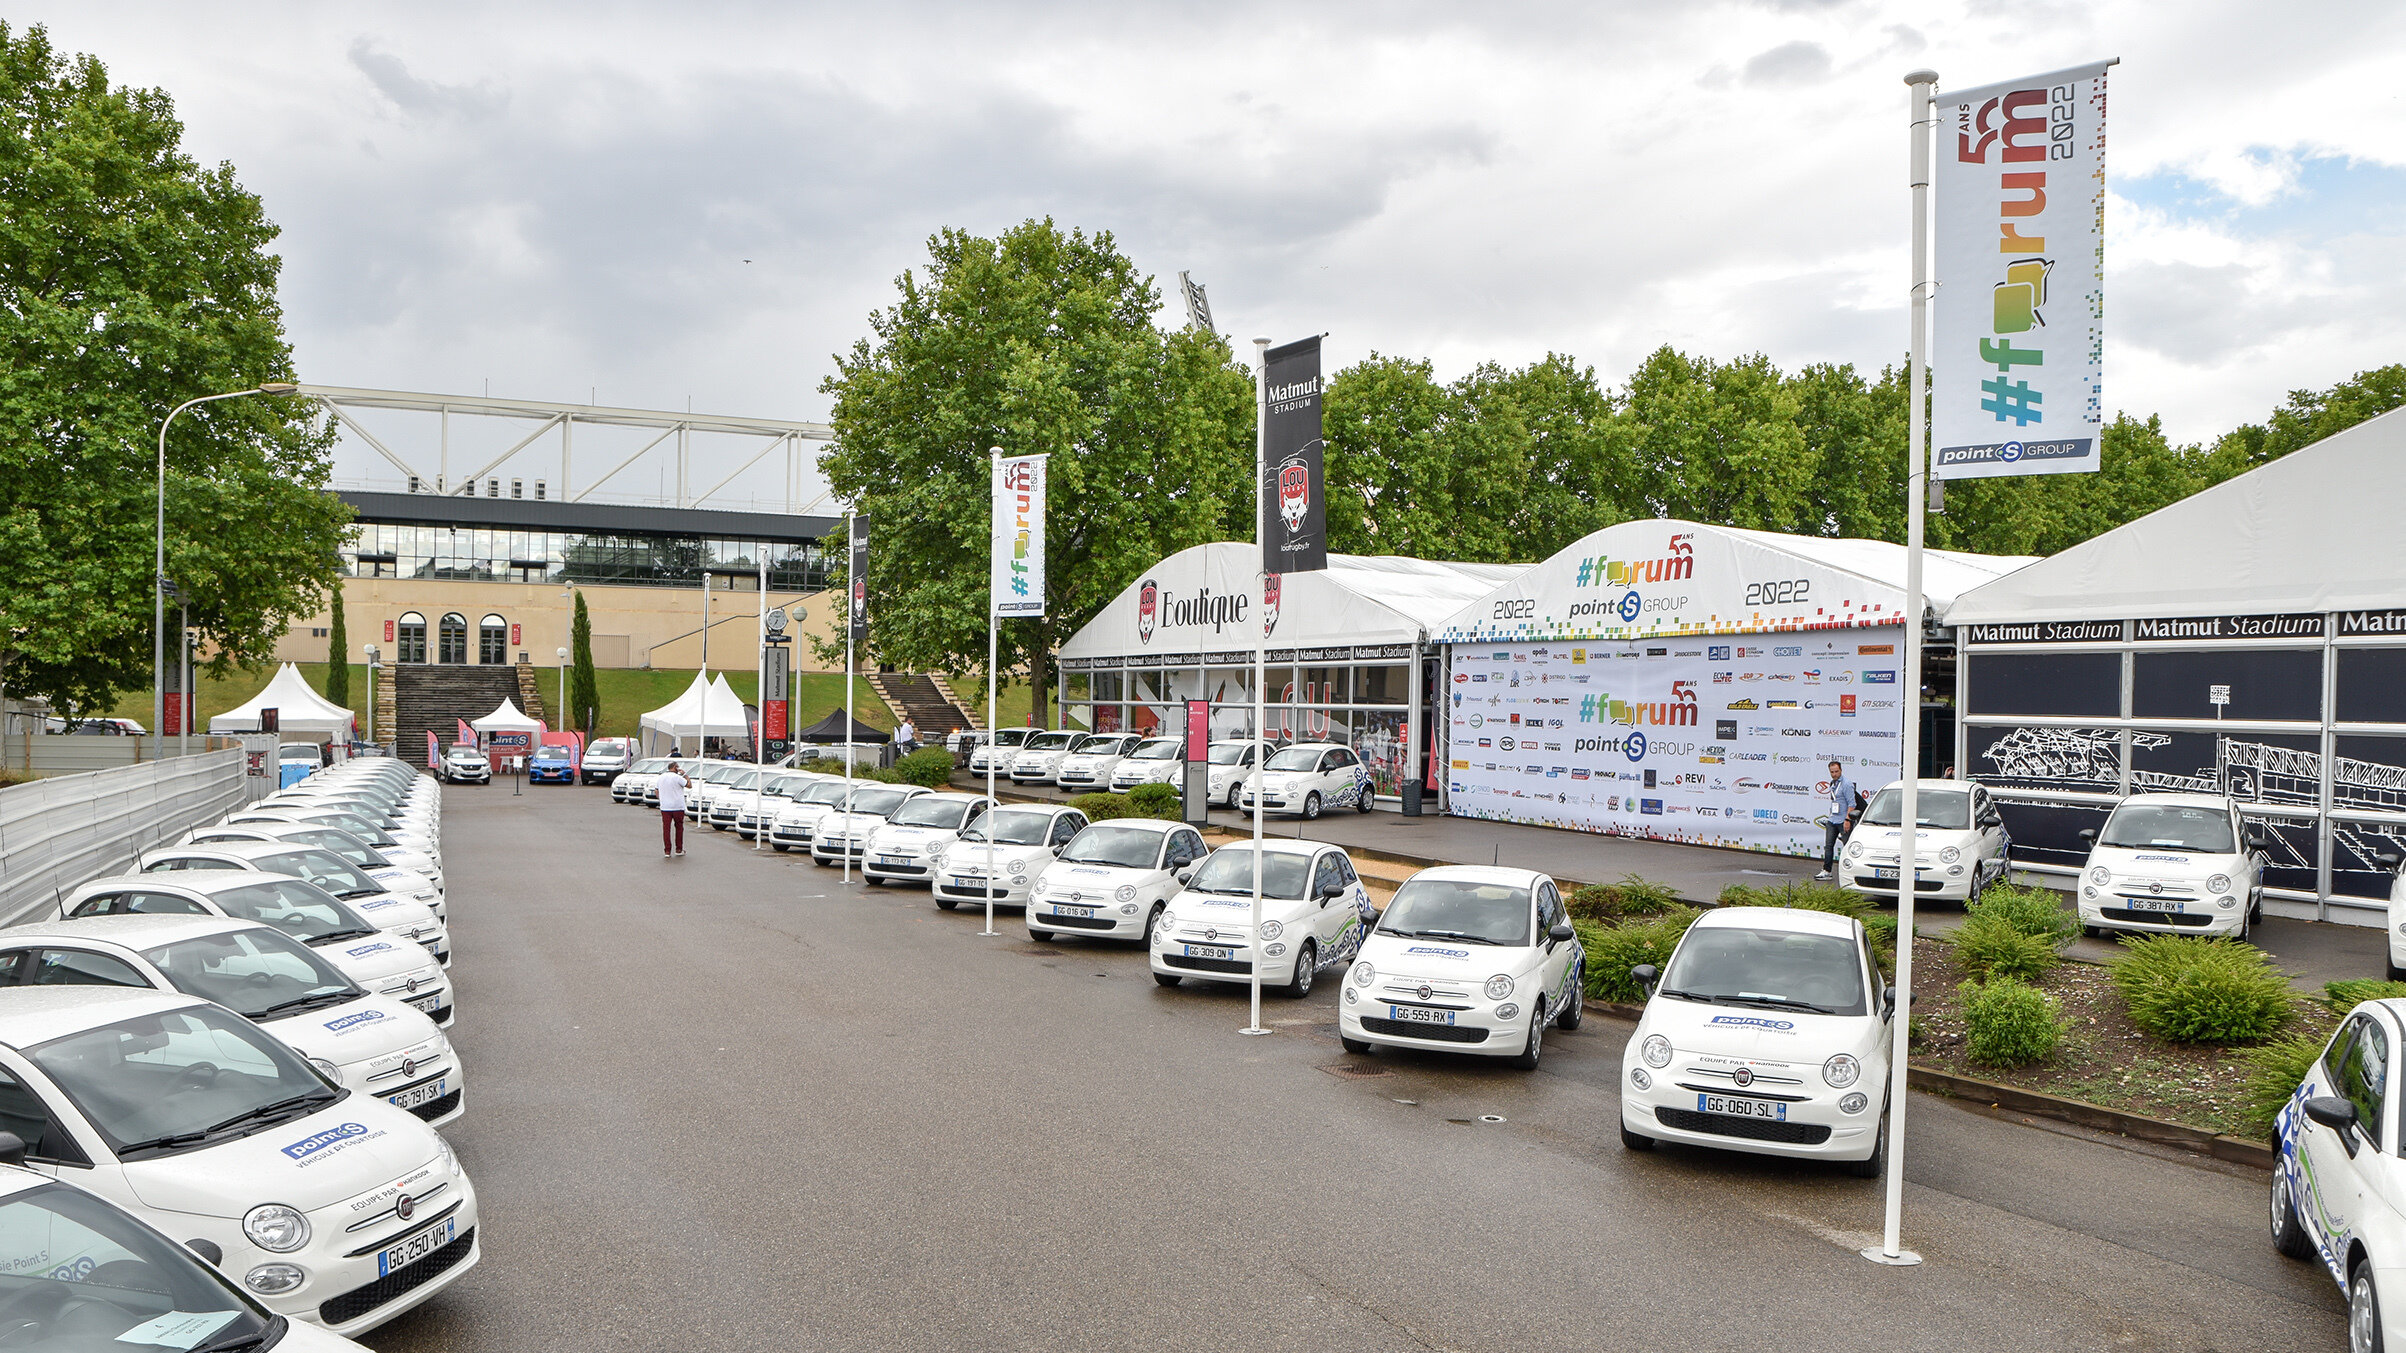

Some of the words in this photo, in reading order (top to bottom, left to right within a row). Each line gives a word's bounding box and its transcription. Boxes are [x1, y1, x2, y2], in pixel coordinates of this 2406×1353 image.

[1959, 103, 1970, 132] ANS
[2051, 83, 2075, 161] 2022
[1268, 375, 1318, 404] Matmut
[1274, 398, 1311, 414] STADIUM
[1942, 446, 1993, 465] point
[2002, 442, 2022, 463] S
[2026, 442, 2075, 457] GROUP
[1282, 469, 1305, 487] LOU
[1141, 591, 1155, 604] LOU
[1745, 579, 1810, 607] 2022
[1161, 587, 1248, 634] Boutique
[1493, 599, 1535, 619] 2022
[1569, 599, 1615, 619] point
[1624, 594, 1639, 618] S
[1643, 596, 1689, 613] GROUP
[1971, 623, 2040, 642] Matmut
[2045, 621, 2120, 640] Stadium
[2137, 617, 2223, 638] Matmut
[2227, 613, 2322, 635] Stadium
[1205, 654, 1225, 663] Matmut
[1225, 653, 1247, 662] Stadium
[1272, 651, 1295, 662] Stadium
[1300, 650, 1323, 660] Matmut
[1324, 649, 1350, 659] Stadium
[1355, 648, 1382, 658] Matmut
[1383, 646, 1411, 657] Stadium
[1128, 657, 1144, 666] Matmut
[1165, 656, 1182, 665] Matmut
[1183, 655, 1201, 664] Stadium
[1548, 719, 1563, 727] IGOL
[1781, 728, 1811, 736] KÖNIG
[1859, 730, 1889, 738] MARANGONI
[518, 735, 527, 745] S
[1575, 736, 1620, 753] point
[1628, 734, 1645, 759] S
[1649, 741, 1695, 756] GROUP
[1729, 753, 1767, 761] CARLEADER
[1780, 755, 1799, 764] opisto
[1816, 752, 1830, 762] OUEST
[1830, 754, 1855, 763] BATTERIES
[1868, 759, 1900, 768] PILKINGTON
[1685, 773, 1706, 784] REVI
[1753, 808, 1778, 819] WAECO
[2133, 900, 2176, 912] GG-387-RX
[1397, 1008, 1446, 1023] GG-559-RX
[1718, 1017, 1768, 1027] point
[396, 1084, 439, 1109] GG-791-SK
[1707, 1097, 1773, 1118] GG-060-SL
[290, 1130, 340, 1160] point
[346, 1130, 388, 1147] COURTOISIE
[383, 1187, 399, 1201] PAR
[388, 1224, 446, 1270] GG-250-VH
[14, 1253, 40, 1270] Point
[41, 1250, 49, 1262] S
